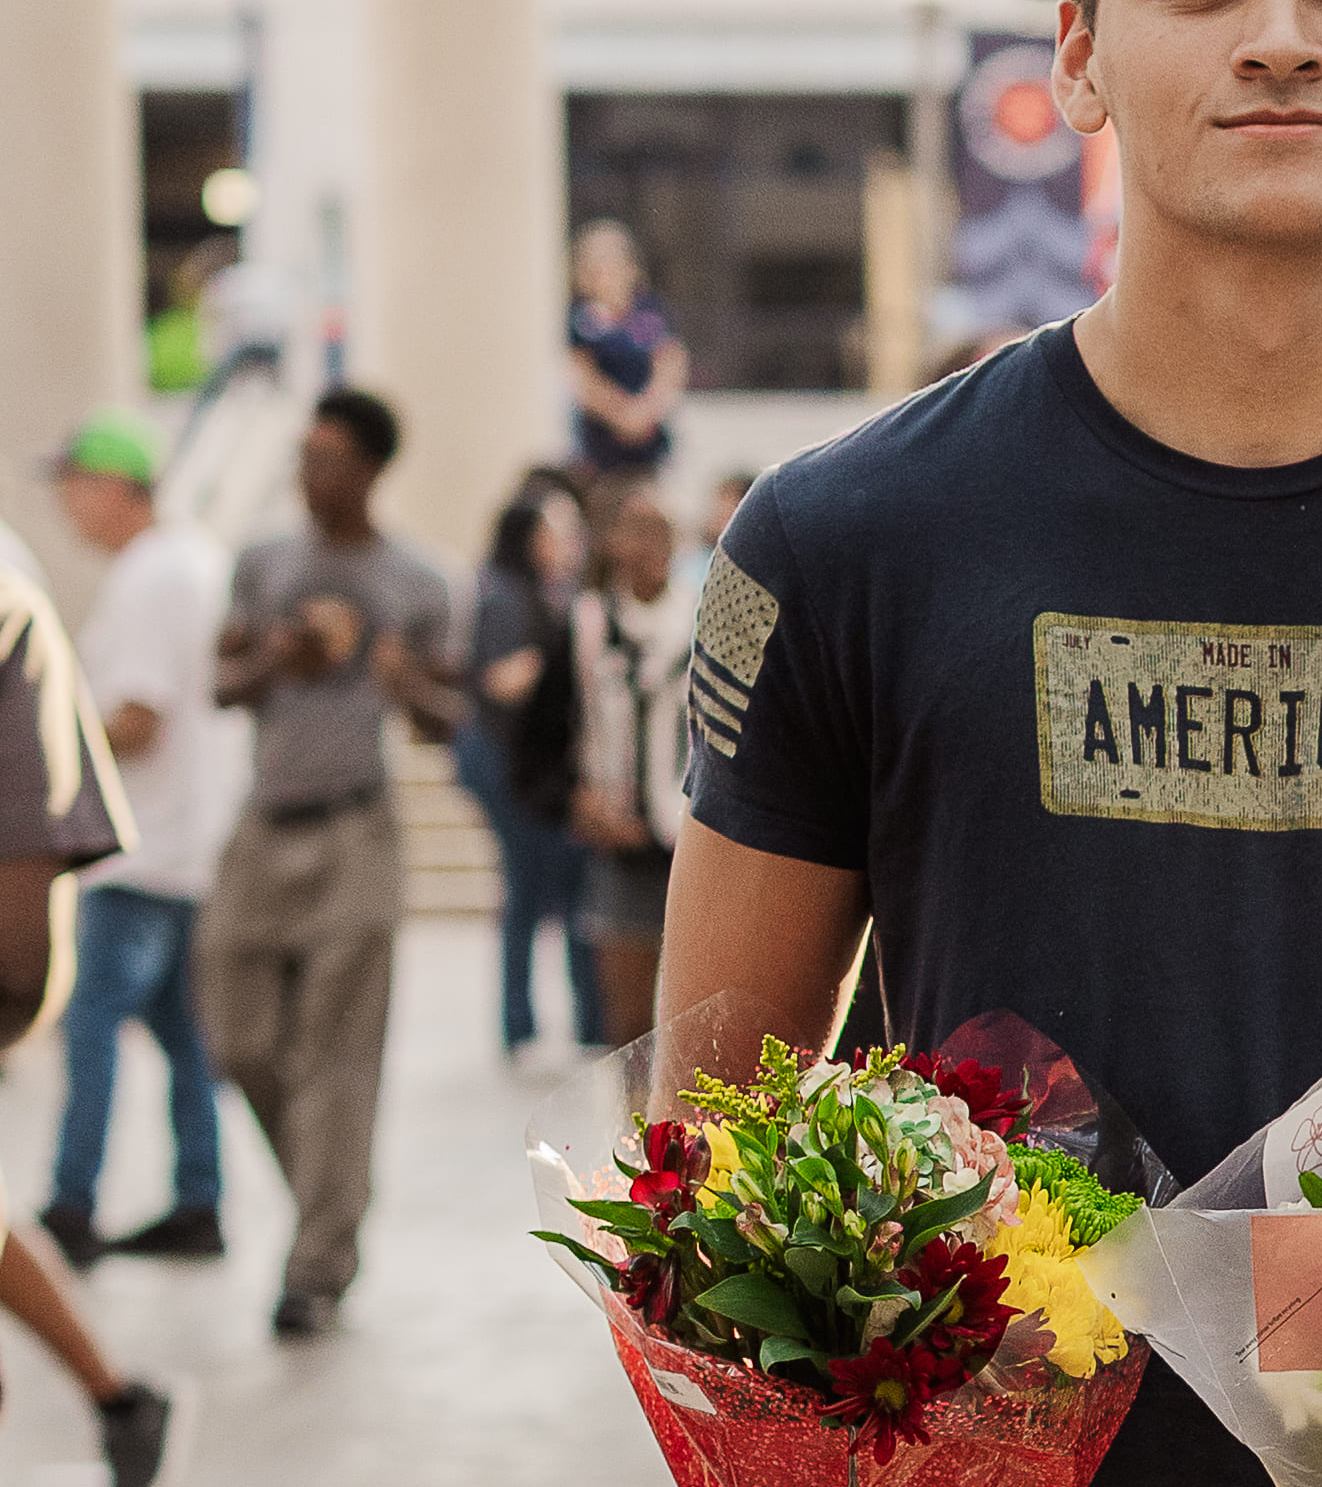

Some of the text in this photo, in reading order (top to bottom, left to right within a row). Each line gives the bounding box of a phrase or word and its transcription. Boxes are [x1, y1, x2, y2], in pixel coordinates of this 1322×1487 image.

[1062, 632, 1091, 651] JULY
[1202, 641, 1292, 669] MADE IN
